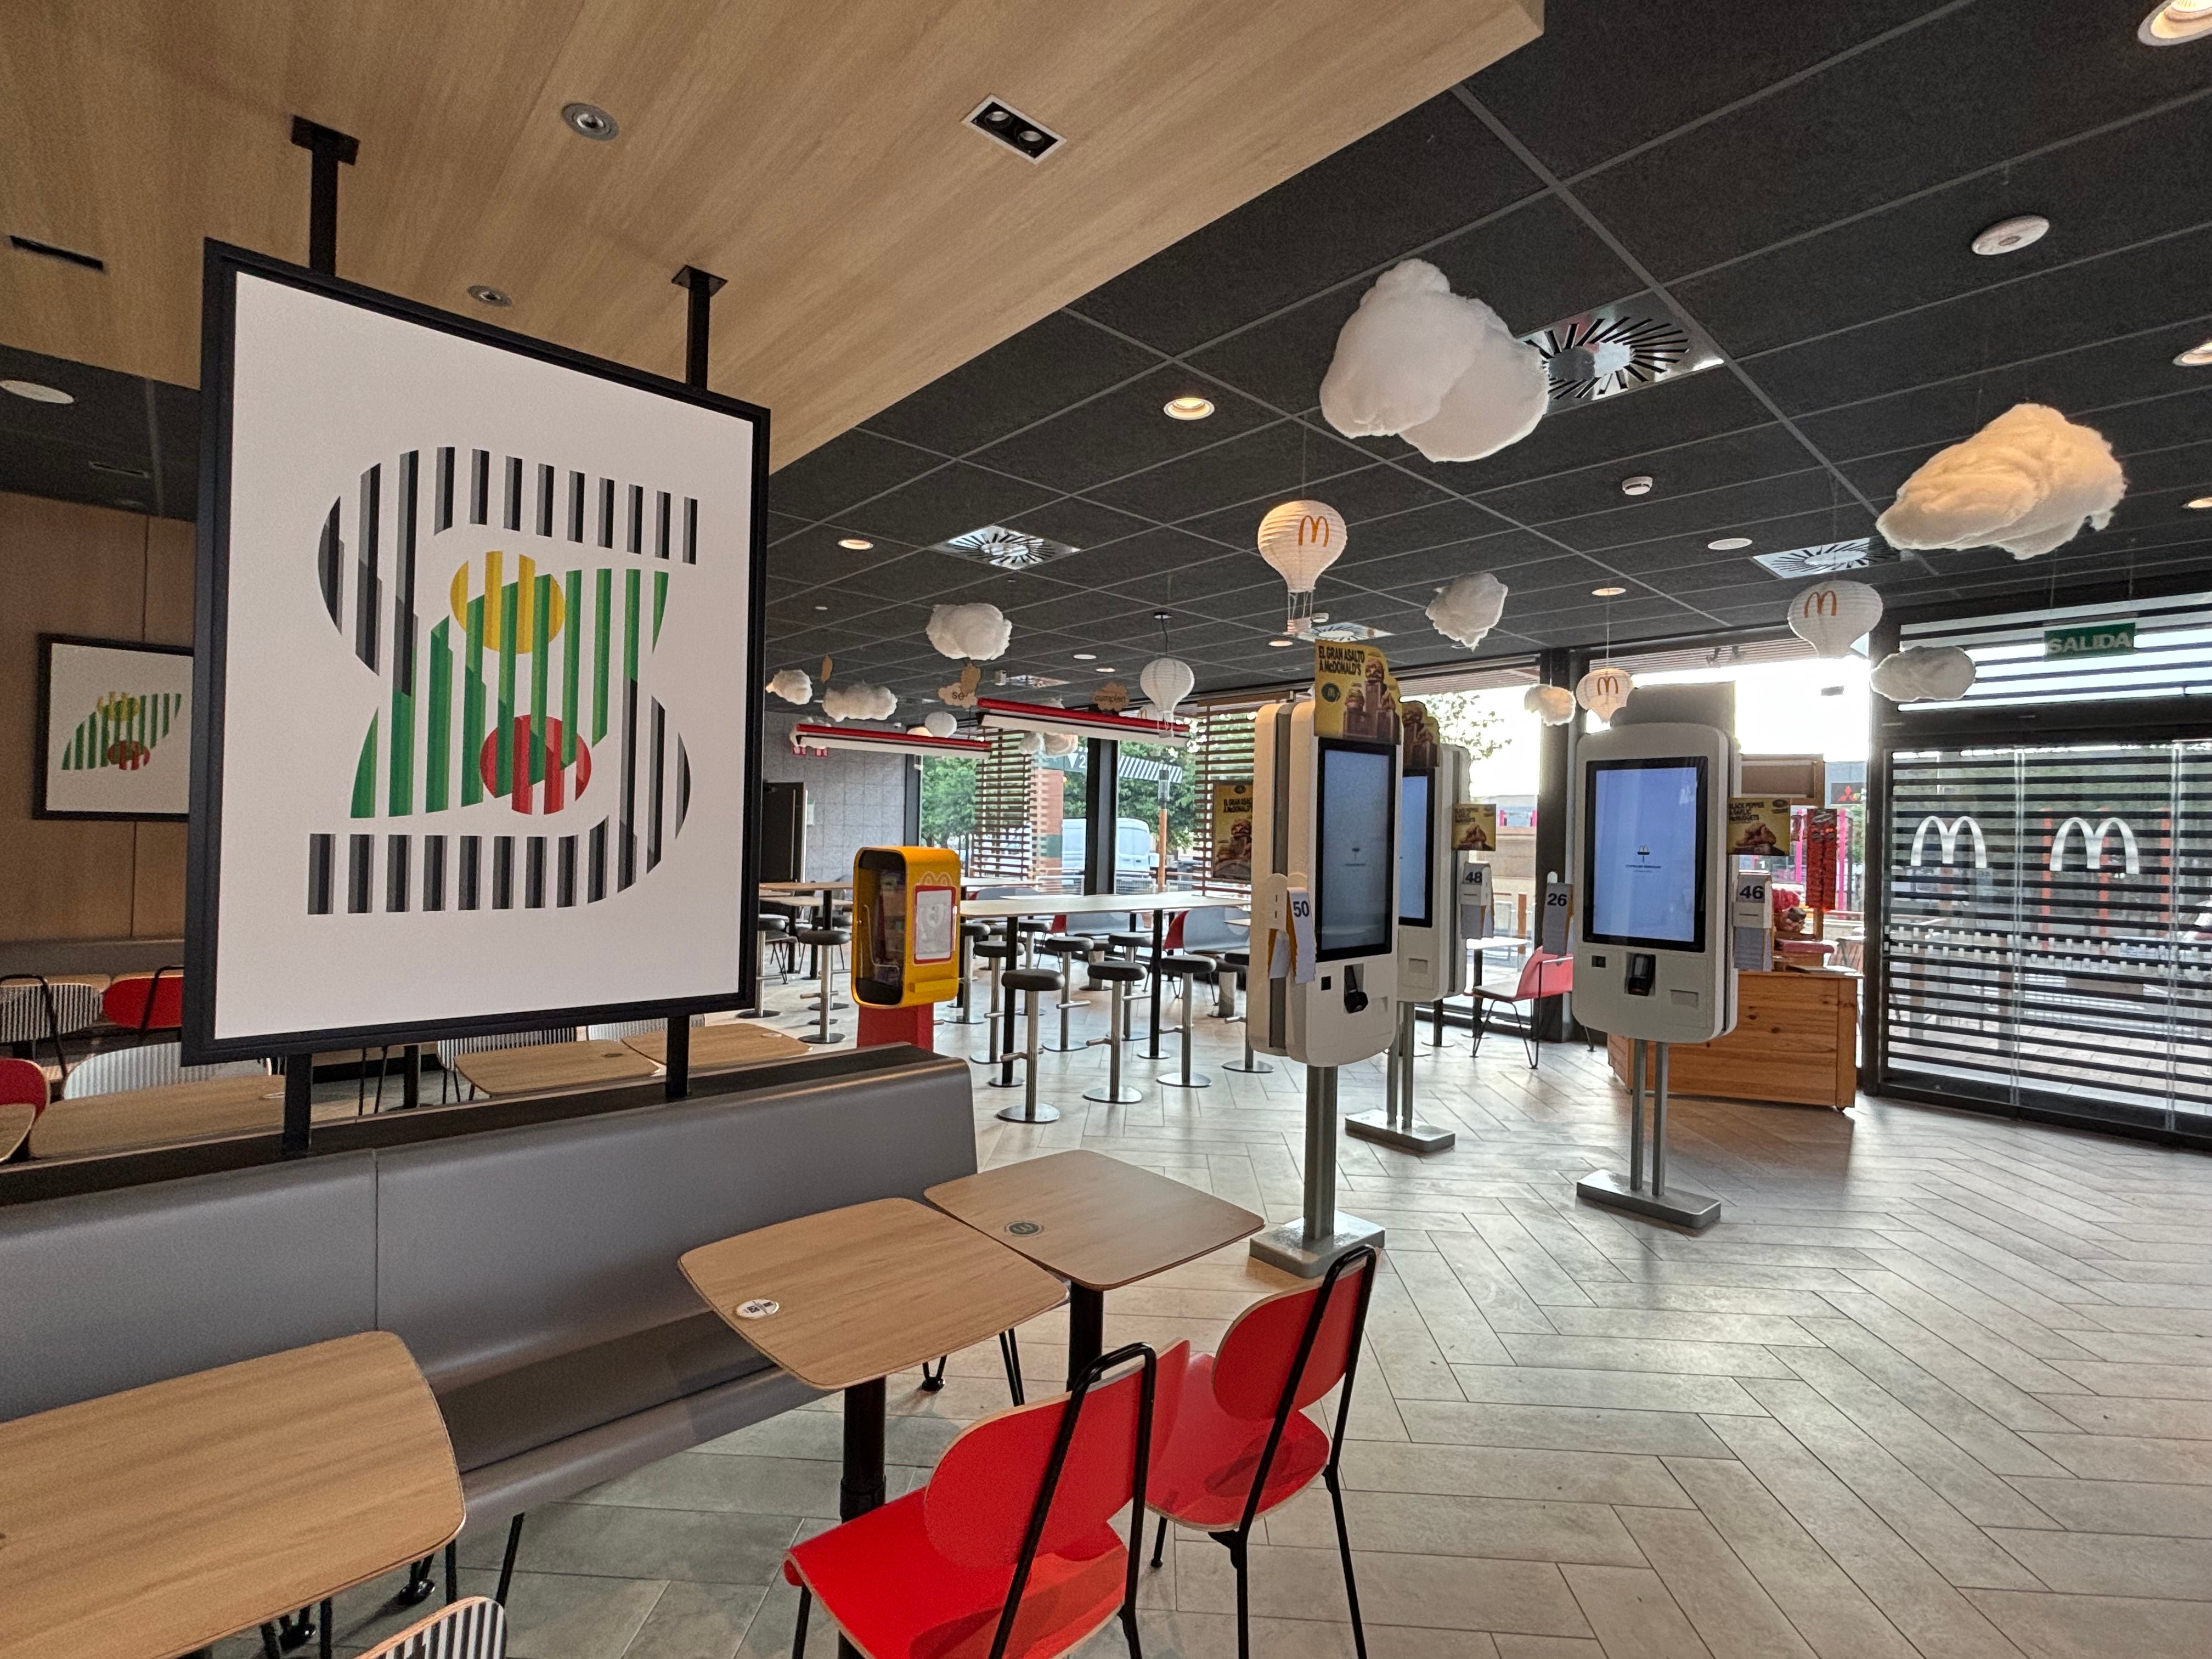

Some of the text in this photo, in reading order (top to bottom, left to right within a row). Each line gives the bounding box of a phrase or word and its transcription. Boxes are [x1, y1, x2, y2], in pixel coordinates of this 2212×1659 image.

[2047, 632, 2132, 653] SALIDA
[1318, 646, 1325, 659] EL
[1327, 646, 1343, 660] GRAN
[1344, 648, 1365, 663] ASALTO
[1319, 659, 1362, 676] A McDONALD'S
[1465, 871, 1482, 883] 48
[1547, 893, 1567, 906] 26
[1739, 885, 1764, 899] 46
[1293, 900, 1310, 917] 50
